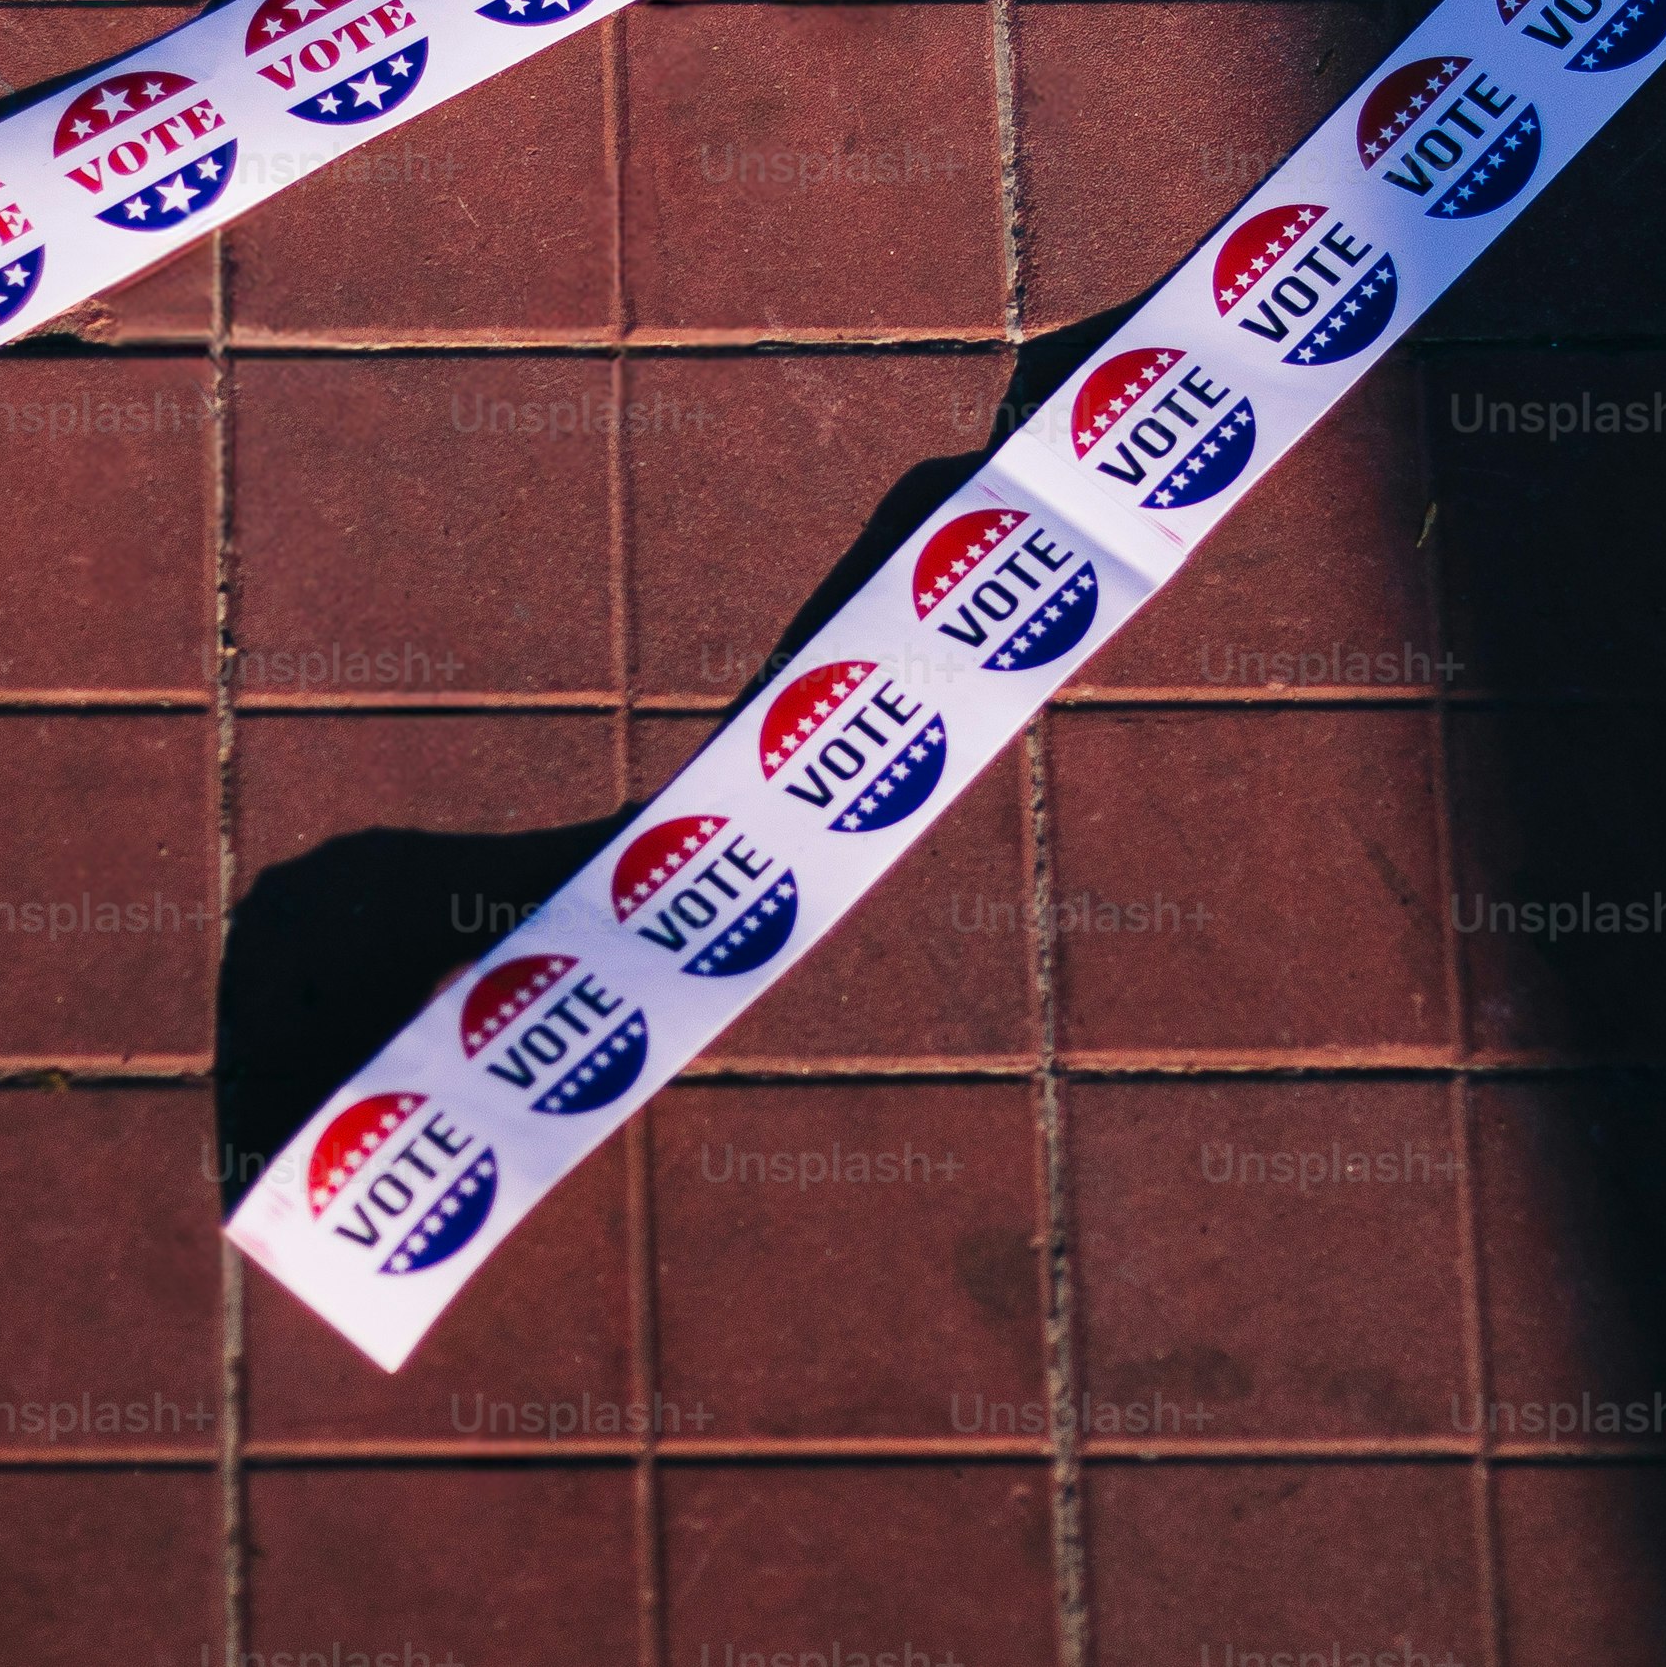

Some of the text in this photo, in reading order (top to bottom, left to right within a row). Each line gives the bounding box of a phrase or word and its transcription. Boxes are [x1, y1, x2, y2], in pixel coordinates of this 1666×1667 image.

[65, 98, 225, 195] VOTE
[1382, 71, 1517, 198] VOTE
[1238, 221, 1373, 344] VOTE
[1096, 365, 1230, 487] VOTE
[938, 527, 1074, 649] VOTE
[785, 678, 923, 809] VOTE
[638, 834, 774, 953] VOTE
[486, 973, 624, 1090] VOTE
[333, 1111, 473, 1250] VOTE
